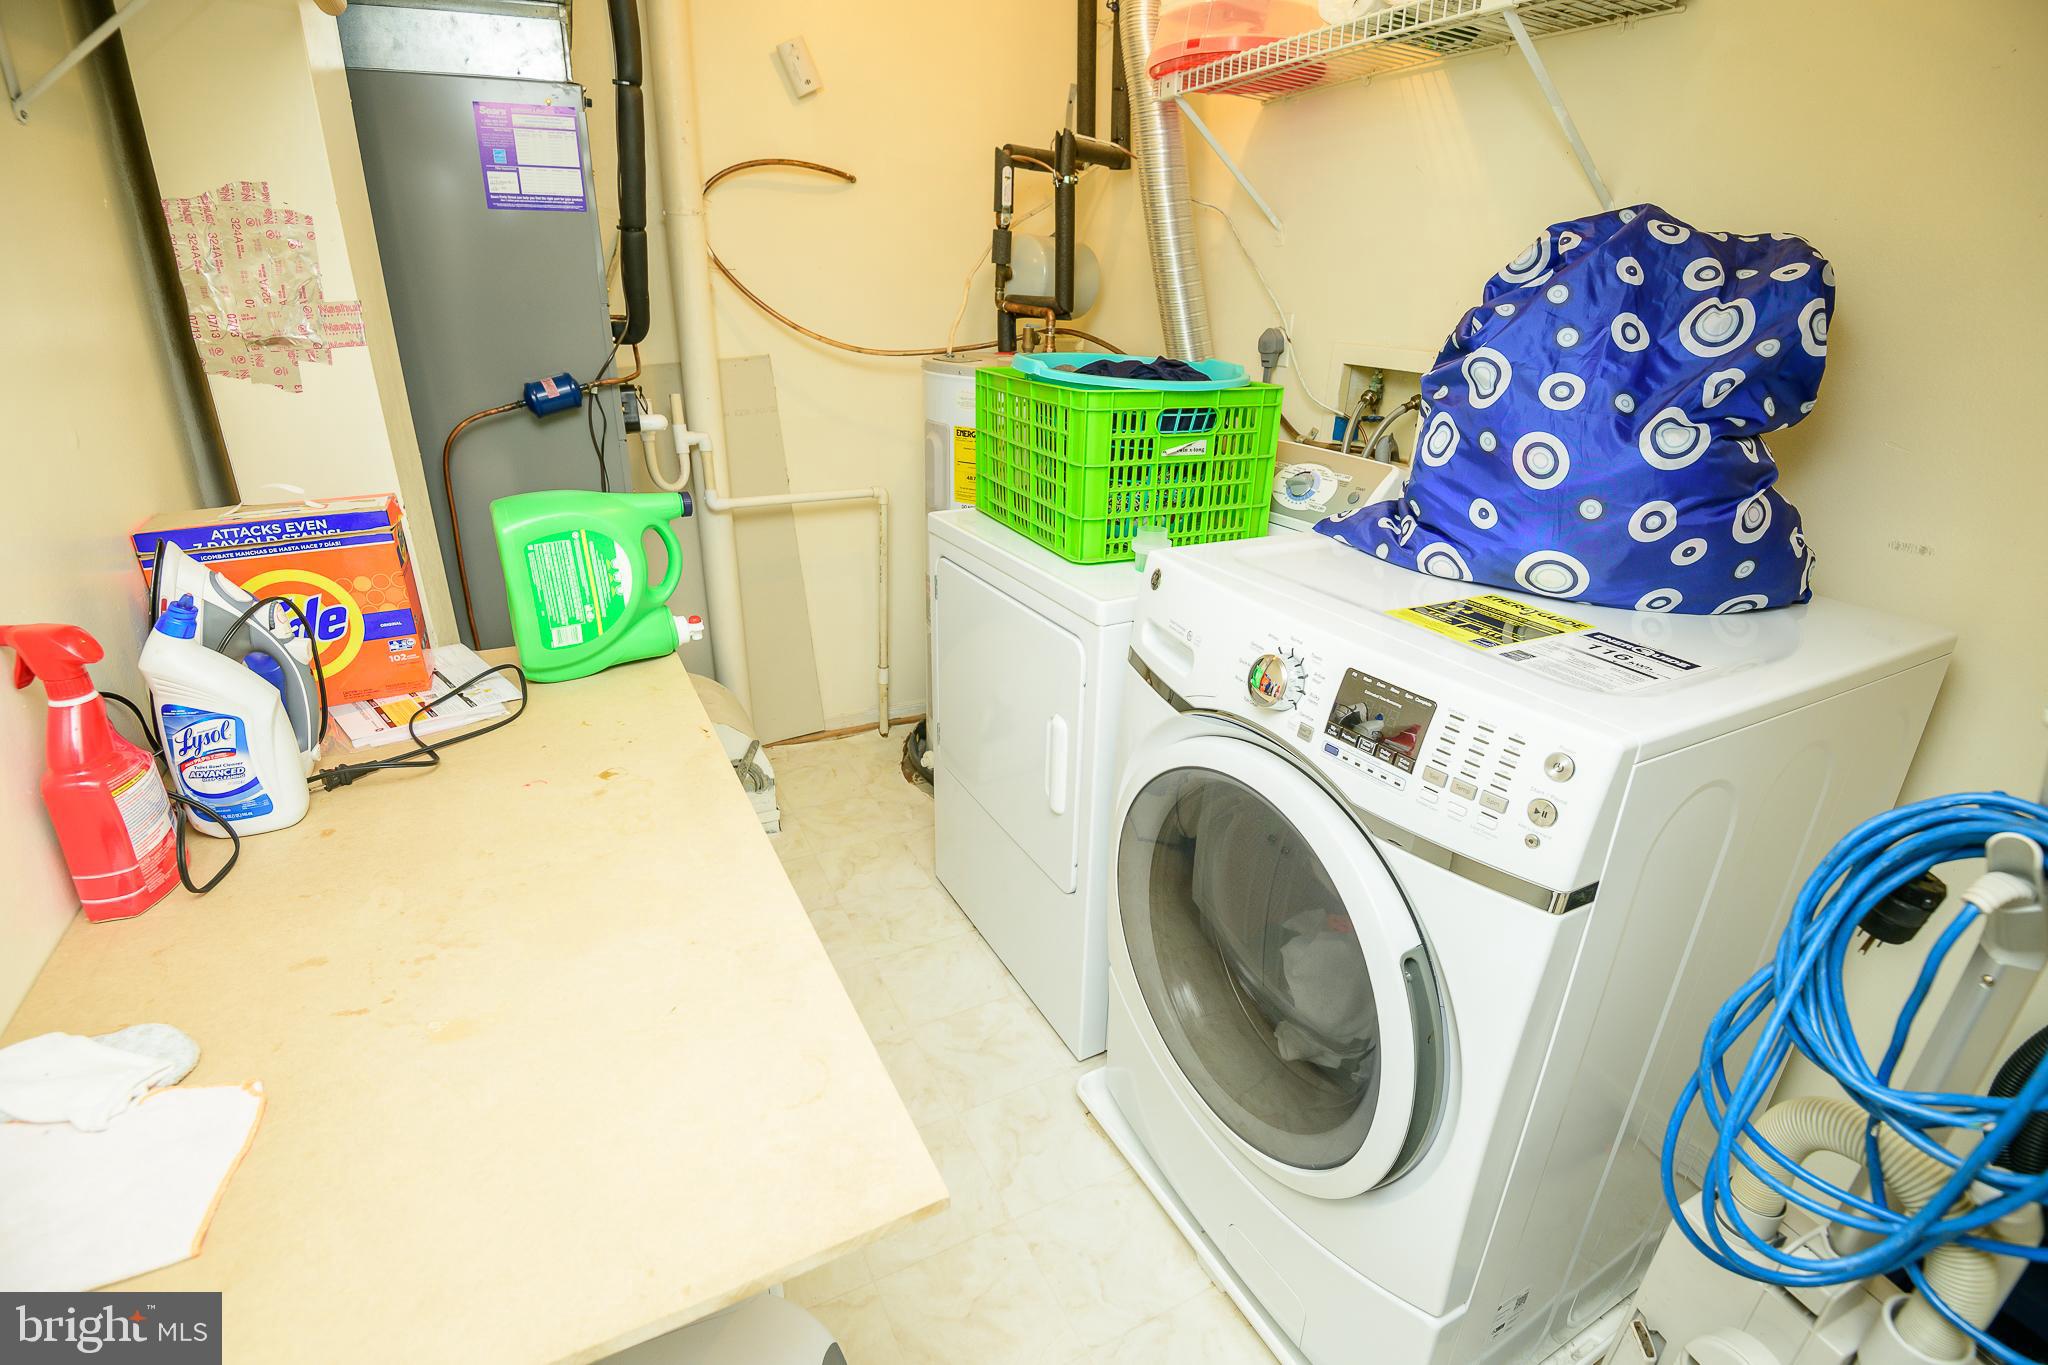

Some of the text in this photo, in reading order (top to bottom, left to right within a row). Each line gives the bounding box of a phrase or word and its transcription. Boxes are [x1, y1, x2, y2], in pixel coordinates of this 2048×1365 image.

[187, 232, 201, 259] 324A
[208, 232, 222, 259] 324A
[206, 313, 221, 339] 07/13
[211, 519, 328, 541] ATTACKS EVEN
[388, 653, 408, 663] 102
[175, 720, 230, 756] Lysol
[189, 767, 246, 779] ADVANCED
